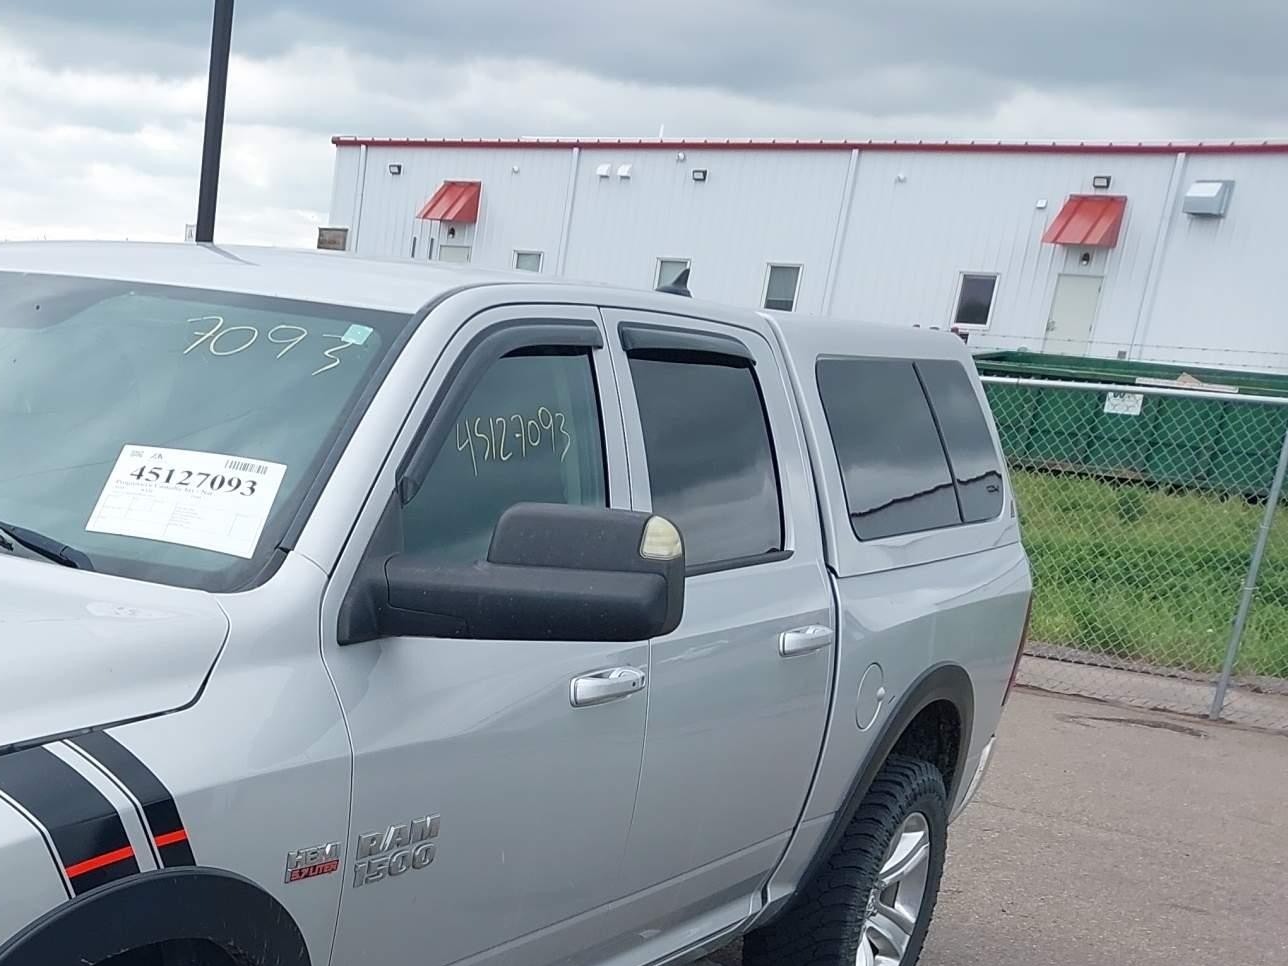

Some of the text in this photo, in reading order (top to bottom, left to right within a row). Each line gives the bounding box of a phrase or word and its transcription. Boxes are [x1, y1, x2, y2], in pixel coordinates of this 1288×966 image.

[184, 316, 353, 376] 7093
[456, 407, 571, 477] 45127093
[129, 464, 258, 497] 45127093
[355, 813, 441, 860] RAM
[309, 860, 339, 876] LITER
[353, 842, 437, 888] 1500
